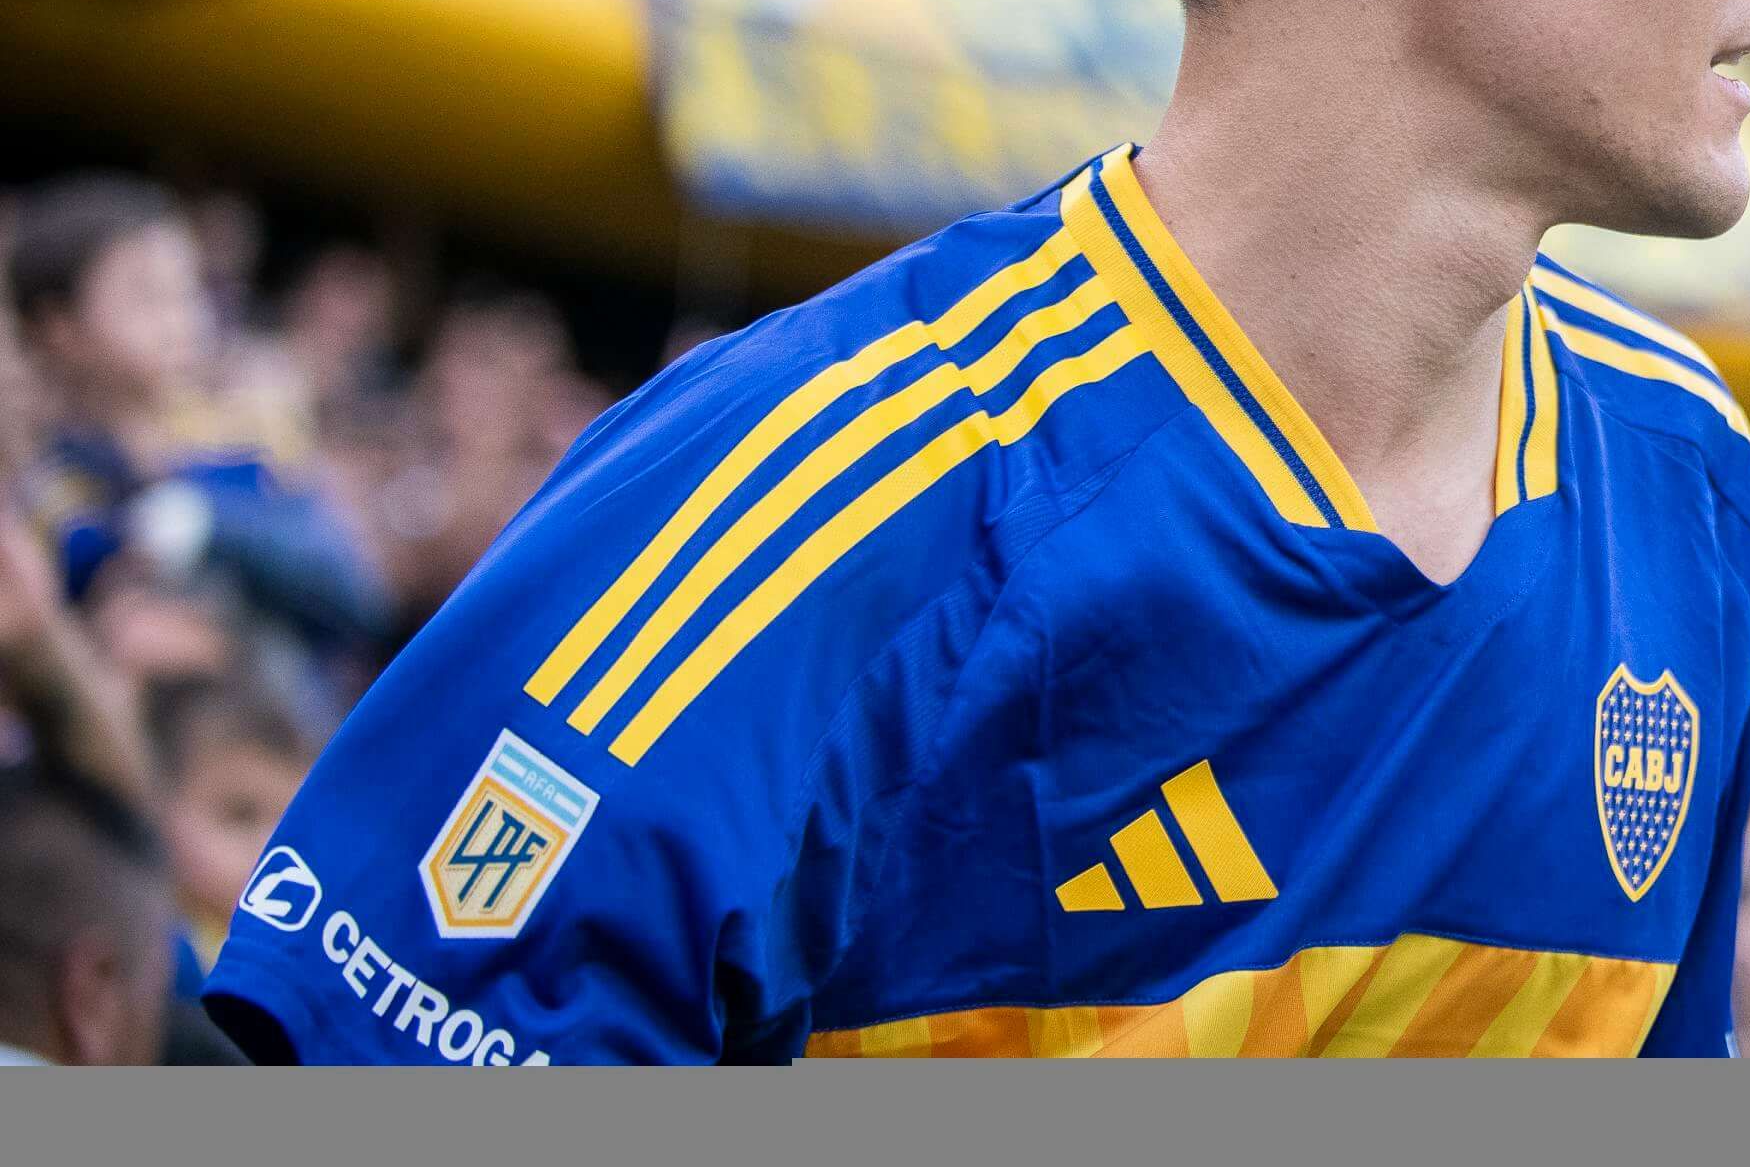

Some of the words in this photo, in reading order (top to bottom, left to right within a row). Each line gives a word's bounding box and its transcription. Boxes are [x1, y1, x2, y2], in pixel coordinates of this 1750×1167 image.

[524, 770, 556, 800] AFA
[1604, 745, 1683, 794] CABJ
[322, 910, 550, 1066] CETROG
